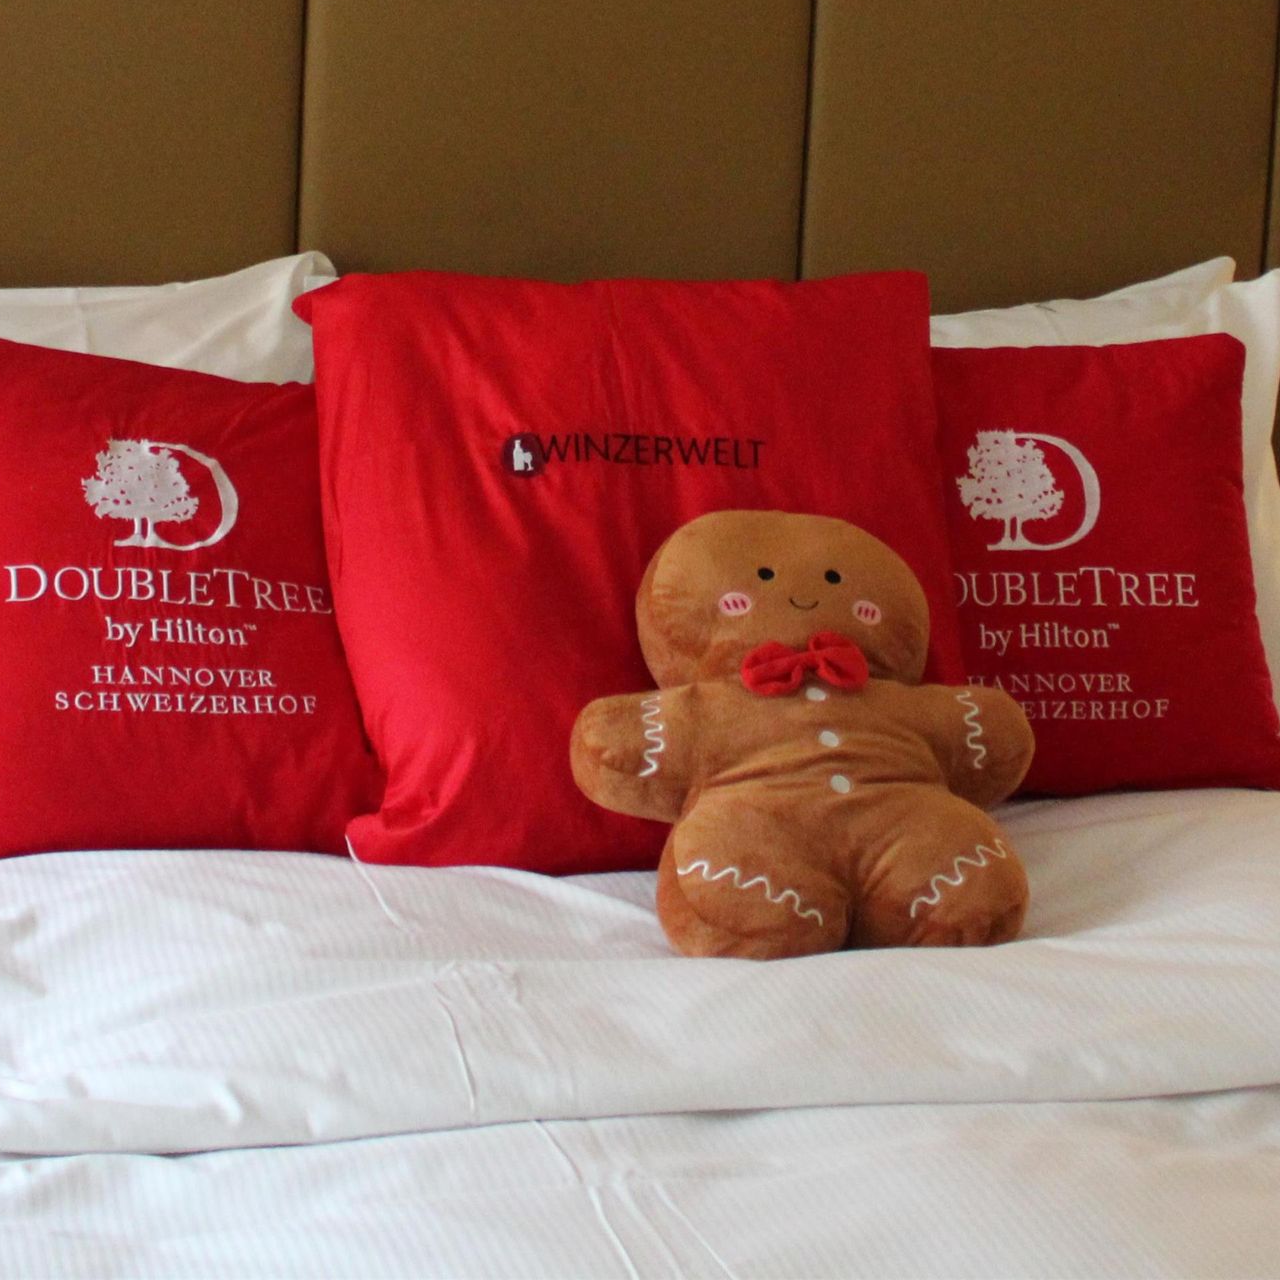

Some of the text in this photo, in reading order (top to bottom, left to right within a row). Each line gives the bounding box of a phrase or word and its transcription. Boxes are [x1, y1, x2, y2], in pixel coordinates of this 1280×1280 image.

[537, 433, 765, 469] WINZERWELT
[3, 564, 335, 614] DOUBLETREE
[953, 566, 1200, 607] UBLETREE
[105, 616, 143, 648] by
[979, 623, 1012, 657] by
[91, 665, 277, 687] HANNOVER
[55, 692, 317, 715] SCHWEIZERHOF
[1020, 699, 1170, 720] EIZERHOF
